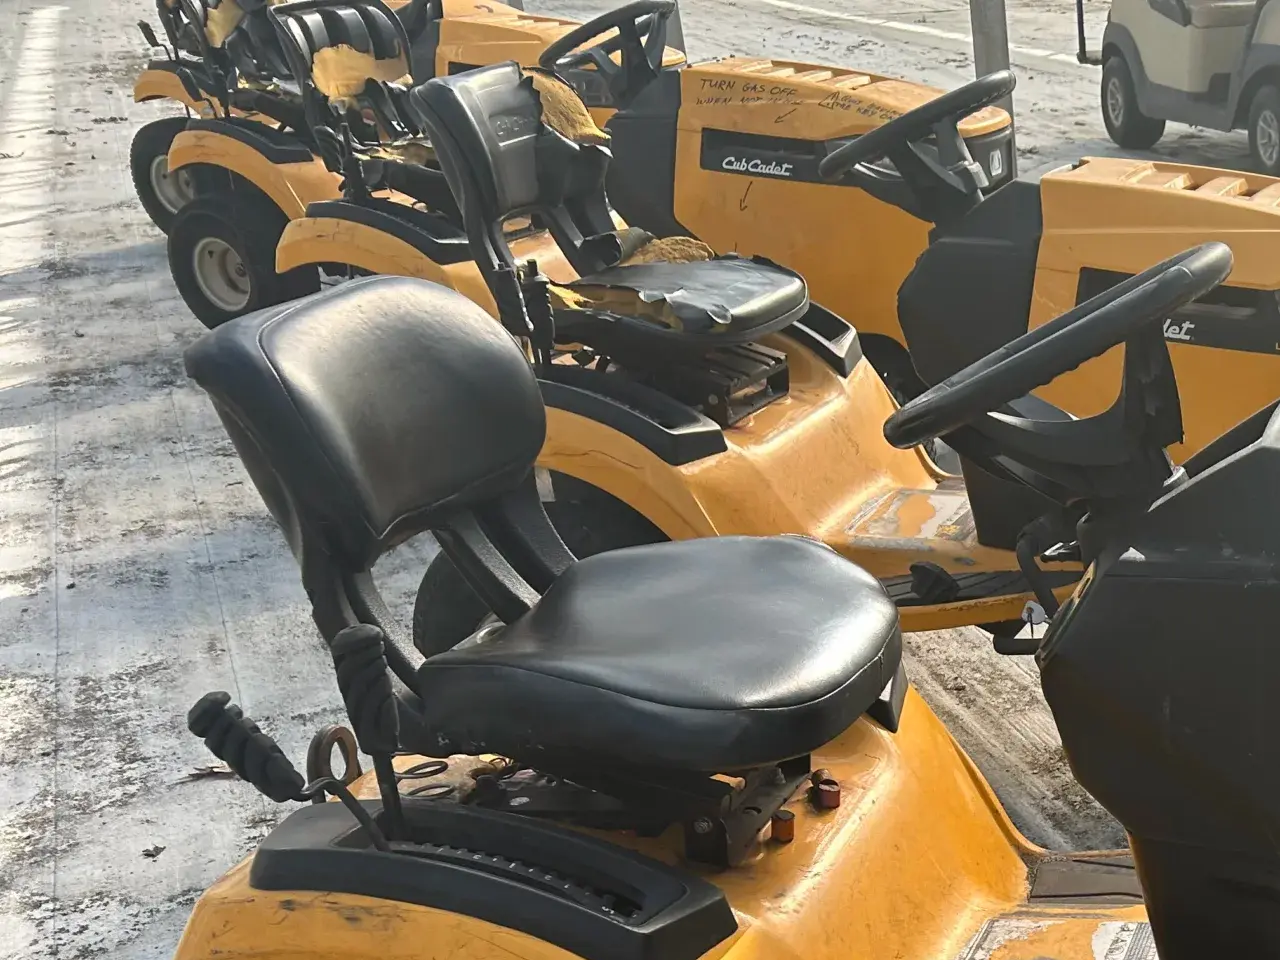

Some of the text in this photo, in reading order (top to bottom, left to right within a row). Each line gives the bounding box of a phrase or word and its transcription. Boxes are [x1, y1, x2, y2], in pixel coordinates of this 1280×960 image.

[700, 78, 798, 96] TURN GAS OFF
[722, 156, 794, 176] Cub Cadet
